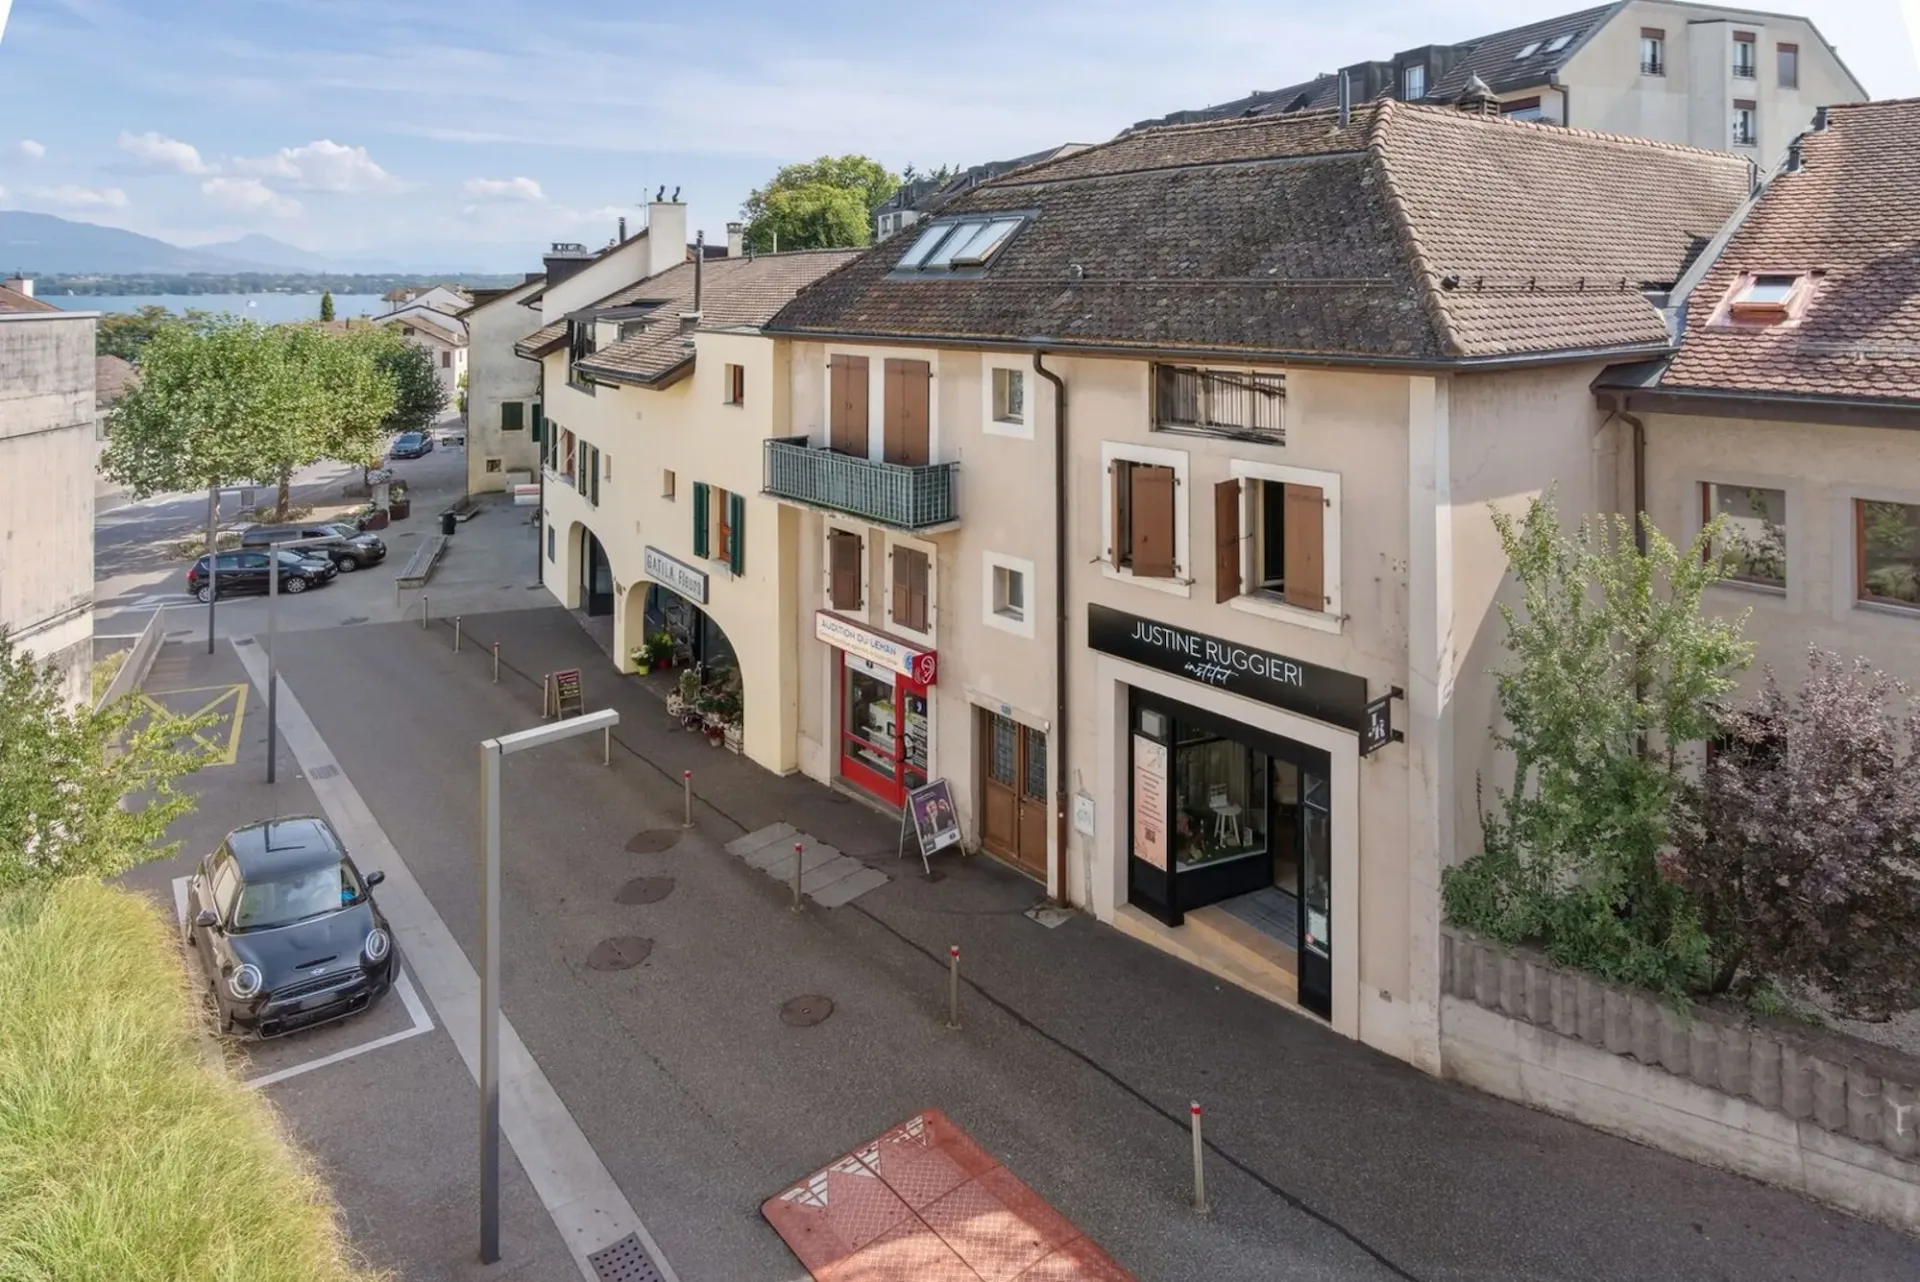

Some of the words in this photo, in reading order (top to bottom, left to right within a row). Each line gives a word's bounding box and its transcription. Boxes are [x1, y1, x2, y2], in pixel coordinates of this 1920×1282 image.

[821, 619, 856, 640] AUDITION
[1131, 621, 1202, 658] JUSTINE
[1205, 640, 1303, 687] RUGGIERI
[1184, 660, 1239, 685] institut
